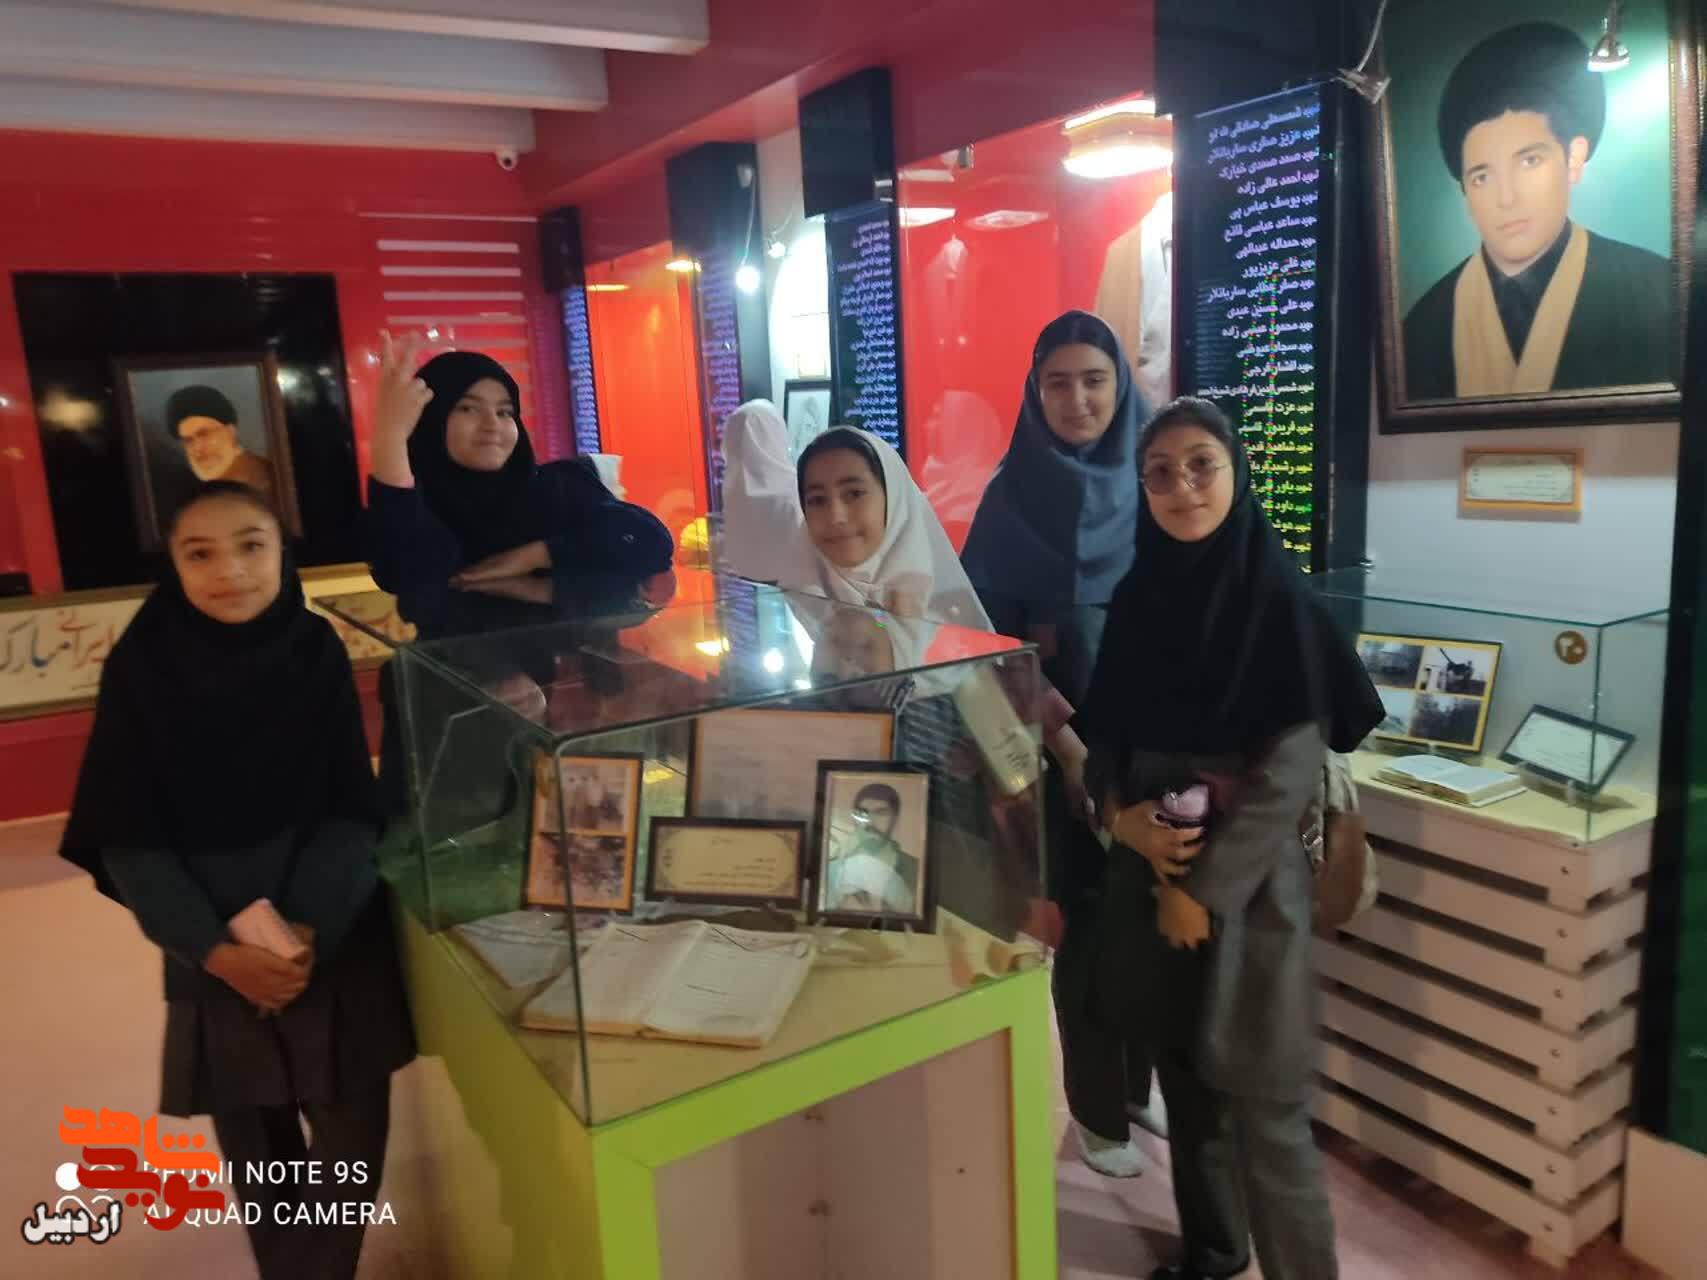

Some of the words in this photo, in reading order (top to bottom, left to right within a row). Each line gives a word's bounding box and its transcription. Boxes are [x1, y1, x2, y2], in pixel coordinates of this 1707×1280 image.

[1279, 170, 1301, 186] احمد
[1238, 181, 1256, 196] زاده
[1243, 200, 1268, 217] عباس
[1270, 195, 1301, 209] یوسف
[1280, 256, 1299, 272] علی
[1280, 298, 1298, 315] علی
[1222, 325, 1239, 339] زاده
